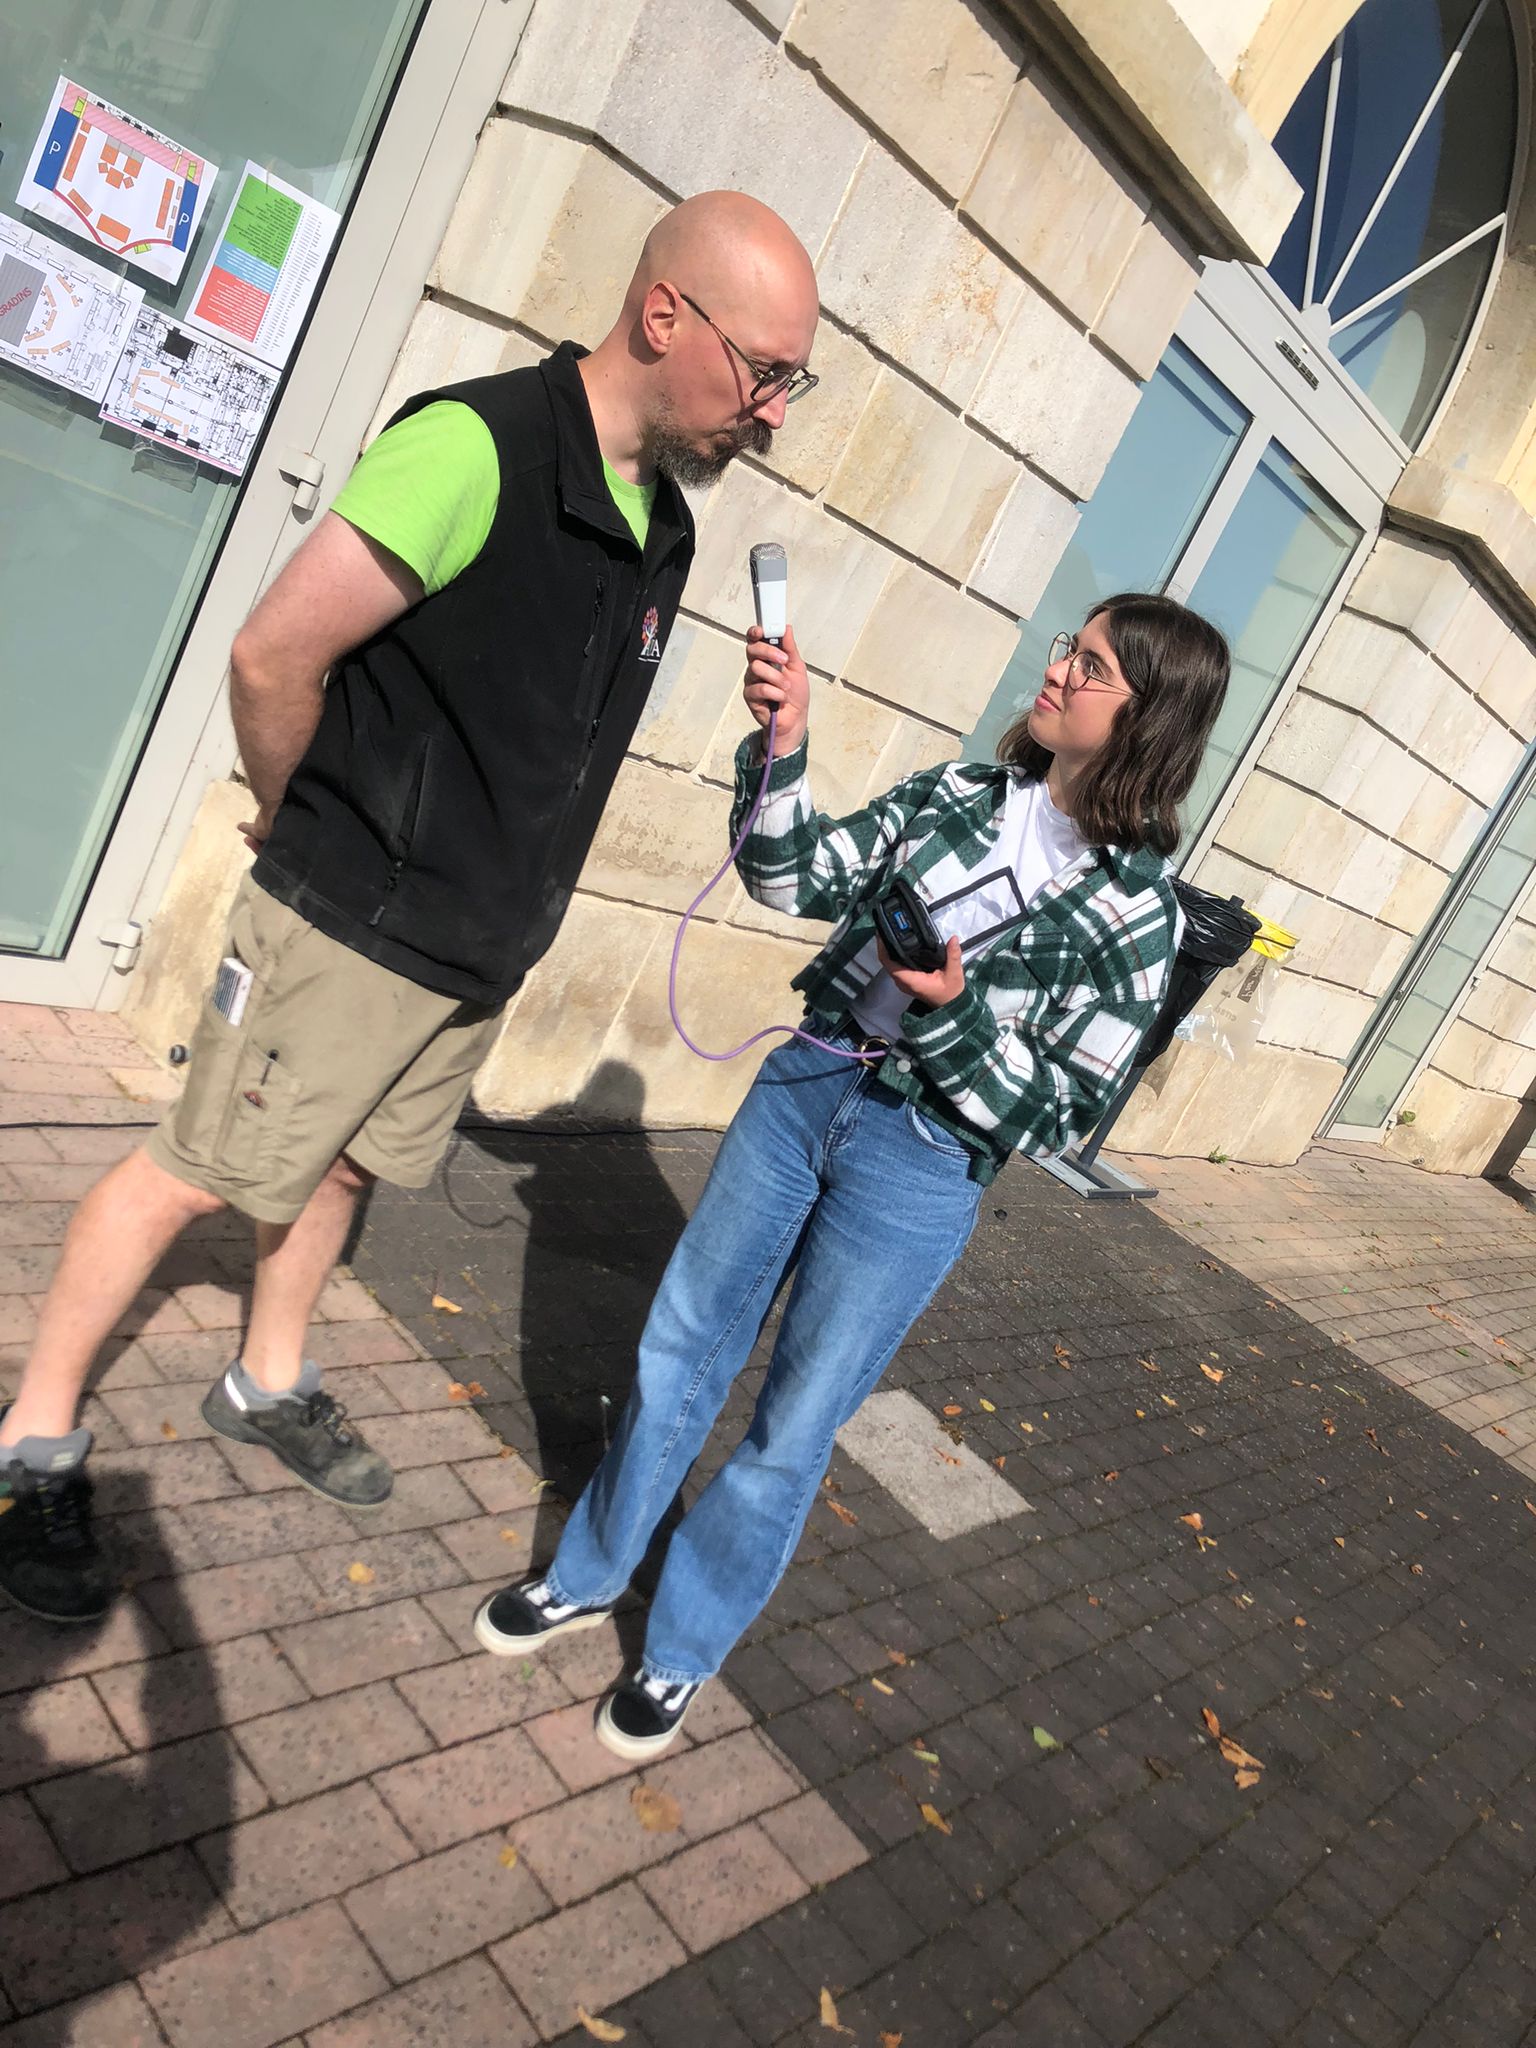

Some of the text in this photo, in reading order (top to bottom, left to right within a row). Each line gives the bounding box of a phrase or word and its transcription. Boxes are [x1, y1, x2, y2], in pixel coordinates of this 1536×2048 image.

[49, 140, 61, 154] P
[178, 212, 190, 226] P
[141, 358, 152, 369] 20
[176, 374, 186, 384] 19
[122, 384, 131, 394] 21
[130, 406, 141, 417] 22
[189, 424, 200, 435] 25
